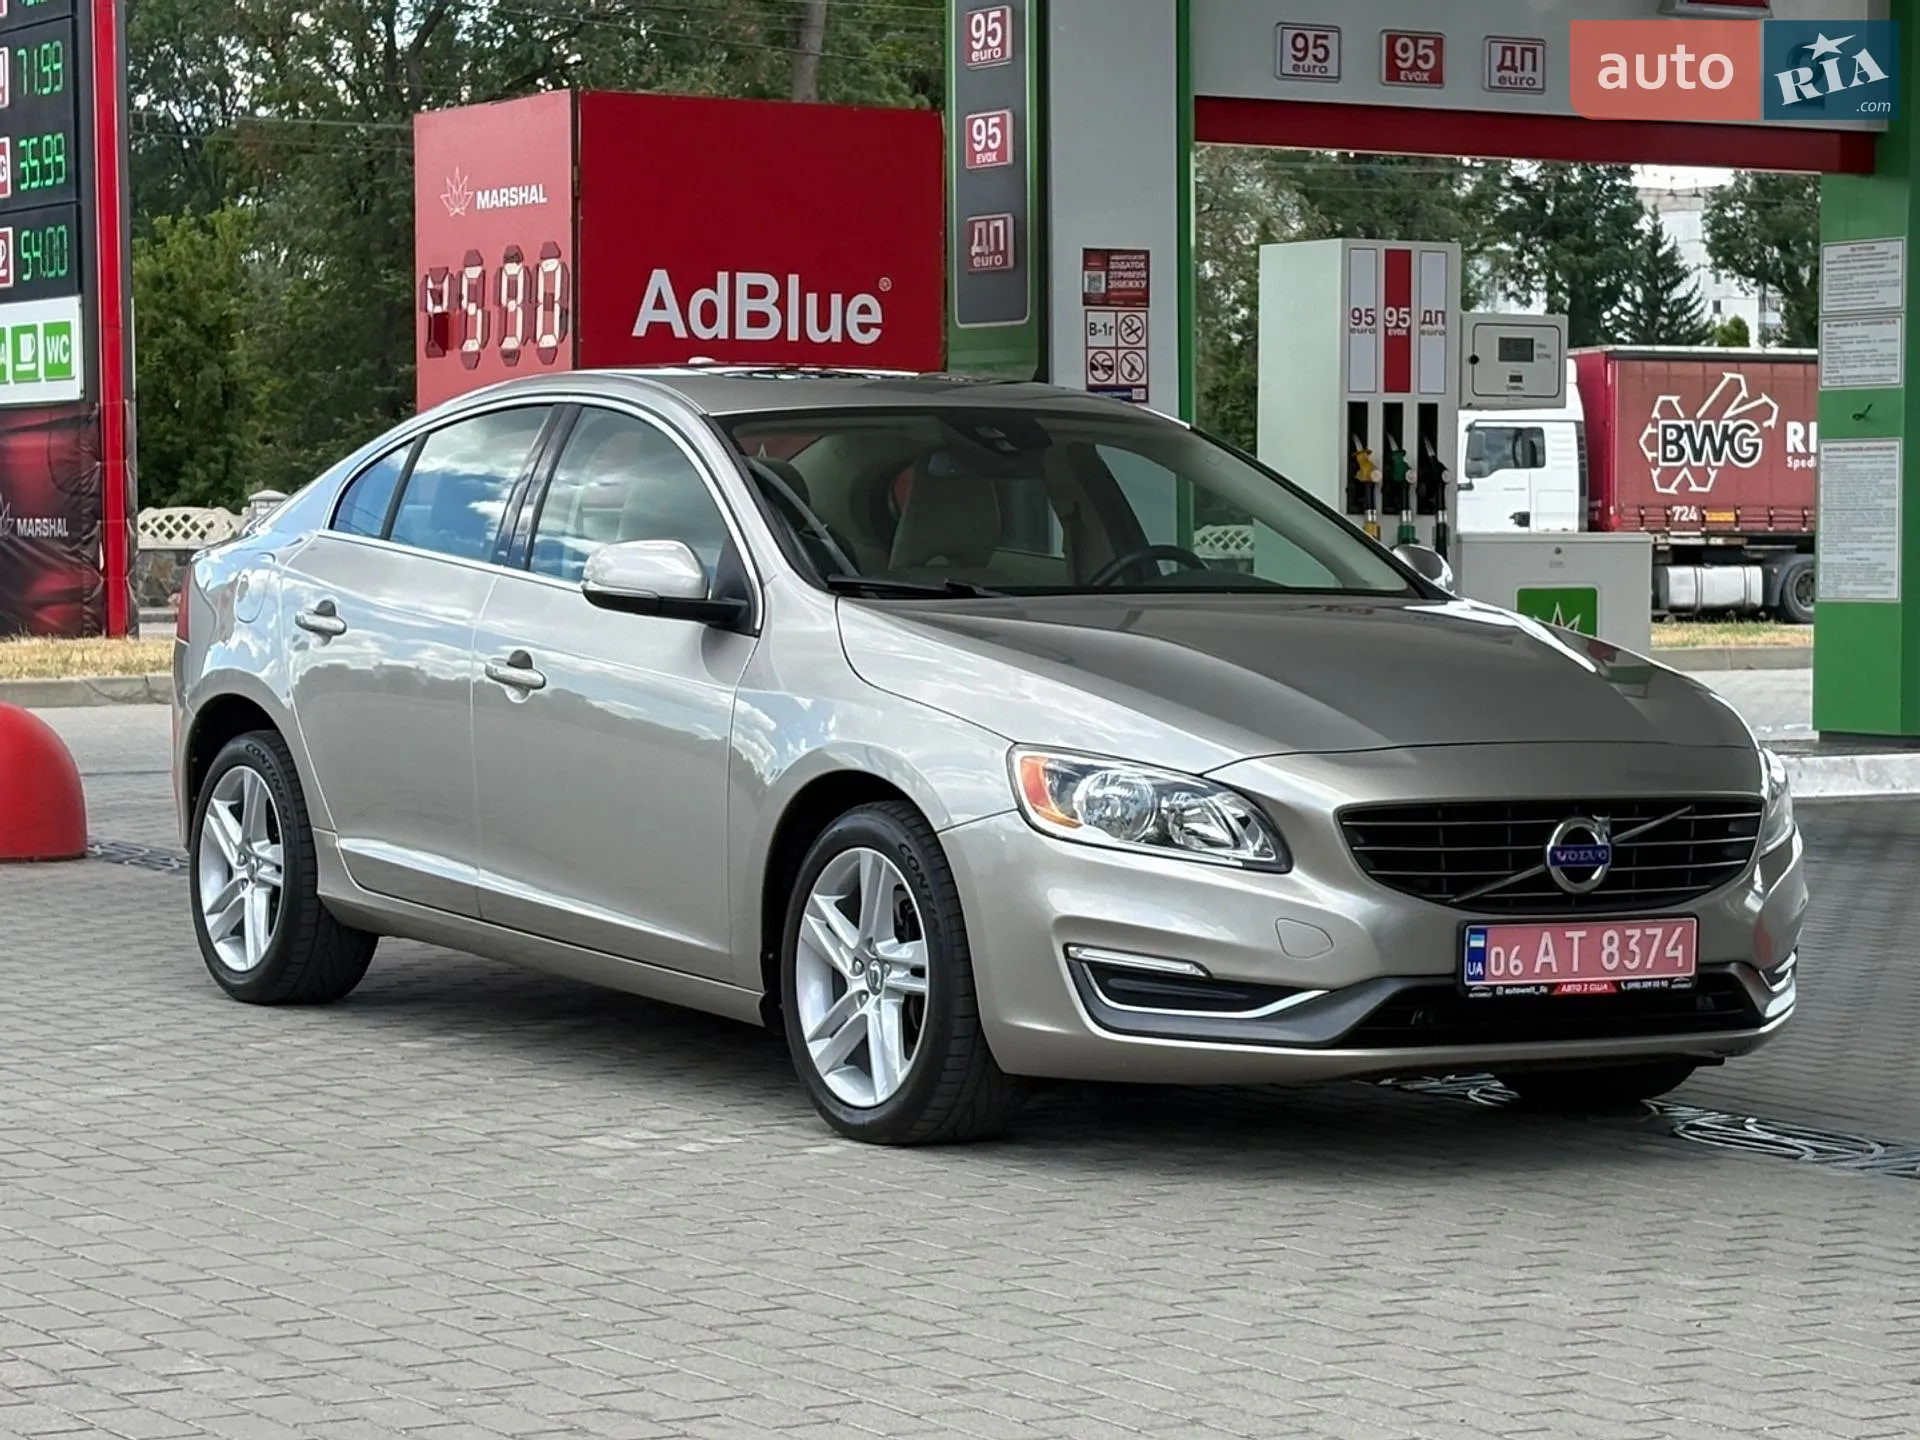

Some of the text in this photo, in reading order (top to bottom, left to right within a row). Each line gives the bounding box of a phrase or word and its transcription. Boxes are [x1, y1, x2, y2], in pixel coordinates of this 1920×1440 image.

[970, 11, 1002, 50] 95
[971, 47, 1002, 62] euro
[1291, 32, 1330, 63] 95
[1394, 37, 1436, 70] 95
[1497, 45, 1537, 73] ДП
[1292, 63, 1328, 75] euro
[1498, 74, 1537, 87] euro
[971, 117, 1002, 151] 95
[476, 184, 548, 210] MARSHAL
[971, 219, 1004, 256] ДП
[972, 254, 1003, 268] euro
[1351, 307, 1376, 326] 95
[1385, 306, 1411, 328] 95
[1420, 309, 1446, 326] ДП
[1350, 327, 1376, 335] euro
[1420, 329, 1446, 337] euro
[46, 333, 70, 365] WC
[1658, 419, 1763, 468] BWG
[1672, 505, 1698, 522] 724
[17, 518, 69, 537] MARSHAL
[1556, 849, 1608, 861] VOLVO
[1490, 945, 1524, 977] 06
[1601, 926, 1684, 972] 8374
[1468, 961, 1484, 976] UA
